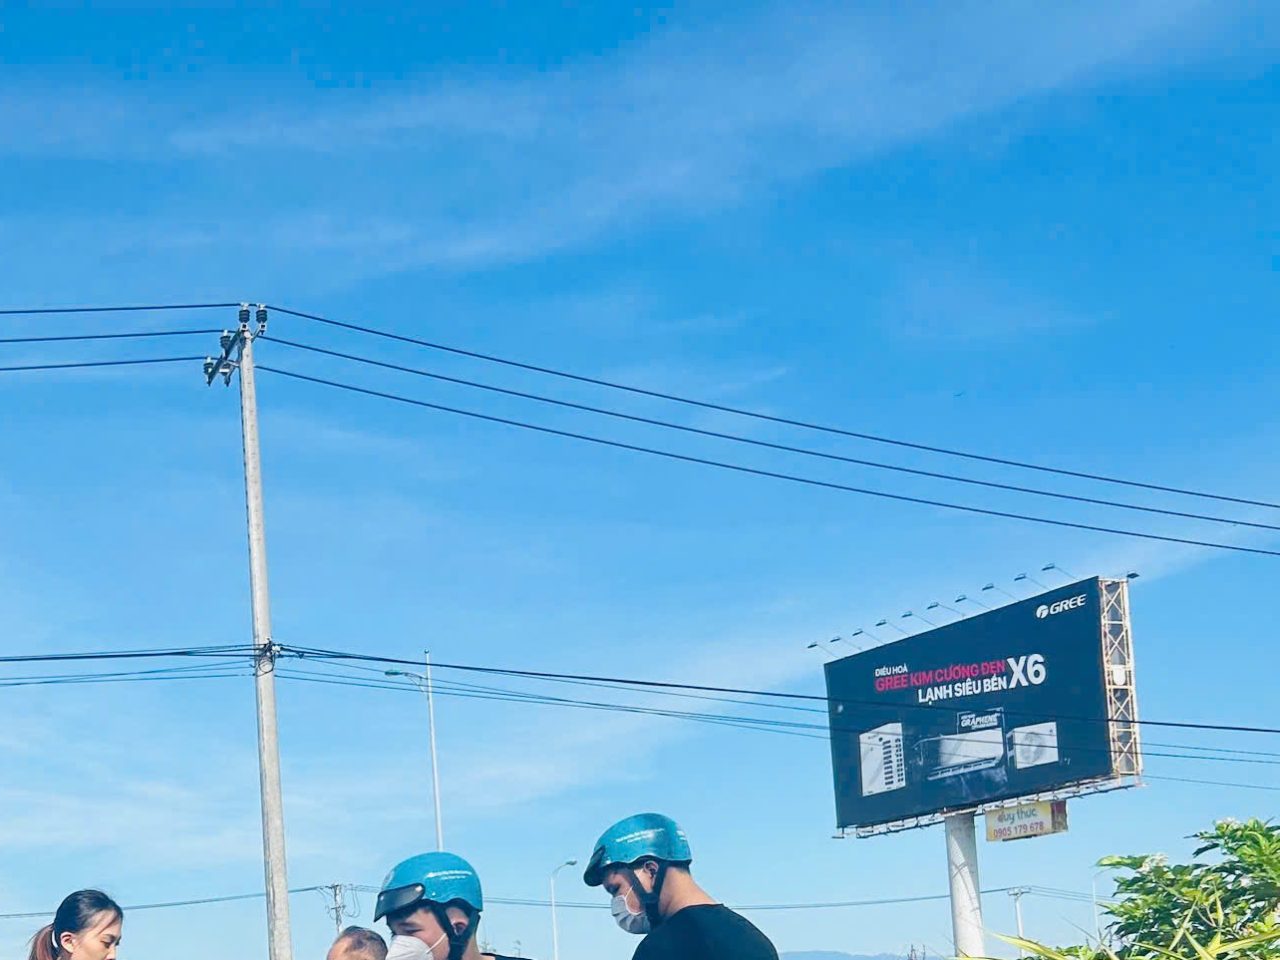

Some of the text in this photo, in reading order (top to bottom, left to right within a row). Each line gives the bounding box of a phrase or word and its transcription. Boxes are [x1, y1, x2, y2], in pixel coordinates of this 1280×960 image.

[1049, 594, 1087, 615] GREE
[875, 674, 908, 692] GREE
[910, 671, 933, 687] KIM
[1007, 653, 1046, 689] X6
[918, 683, 952, 706] LẠNH
[954, 678, 982, 698] SIÊU
[1014, 824, 1028, 835] 179
